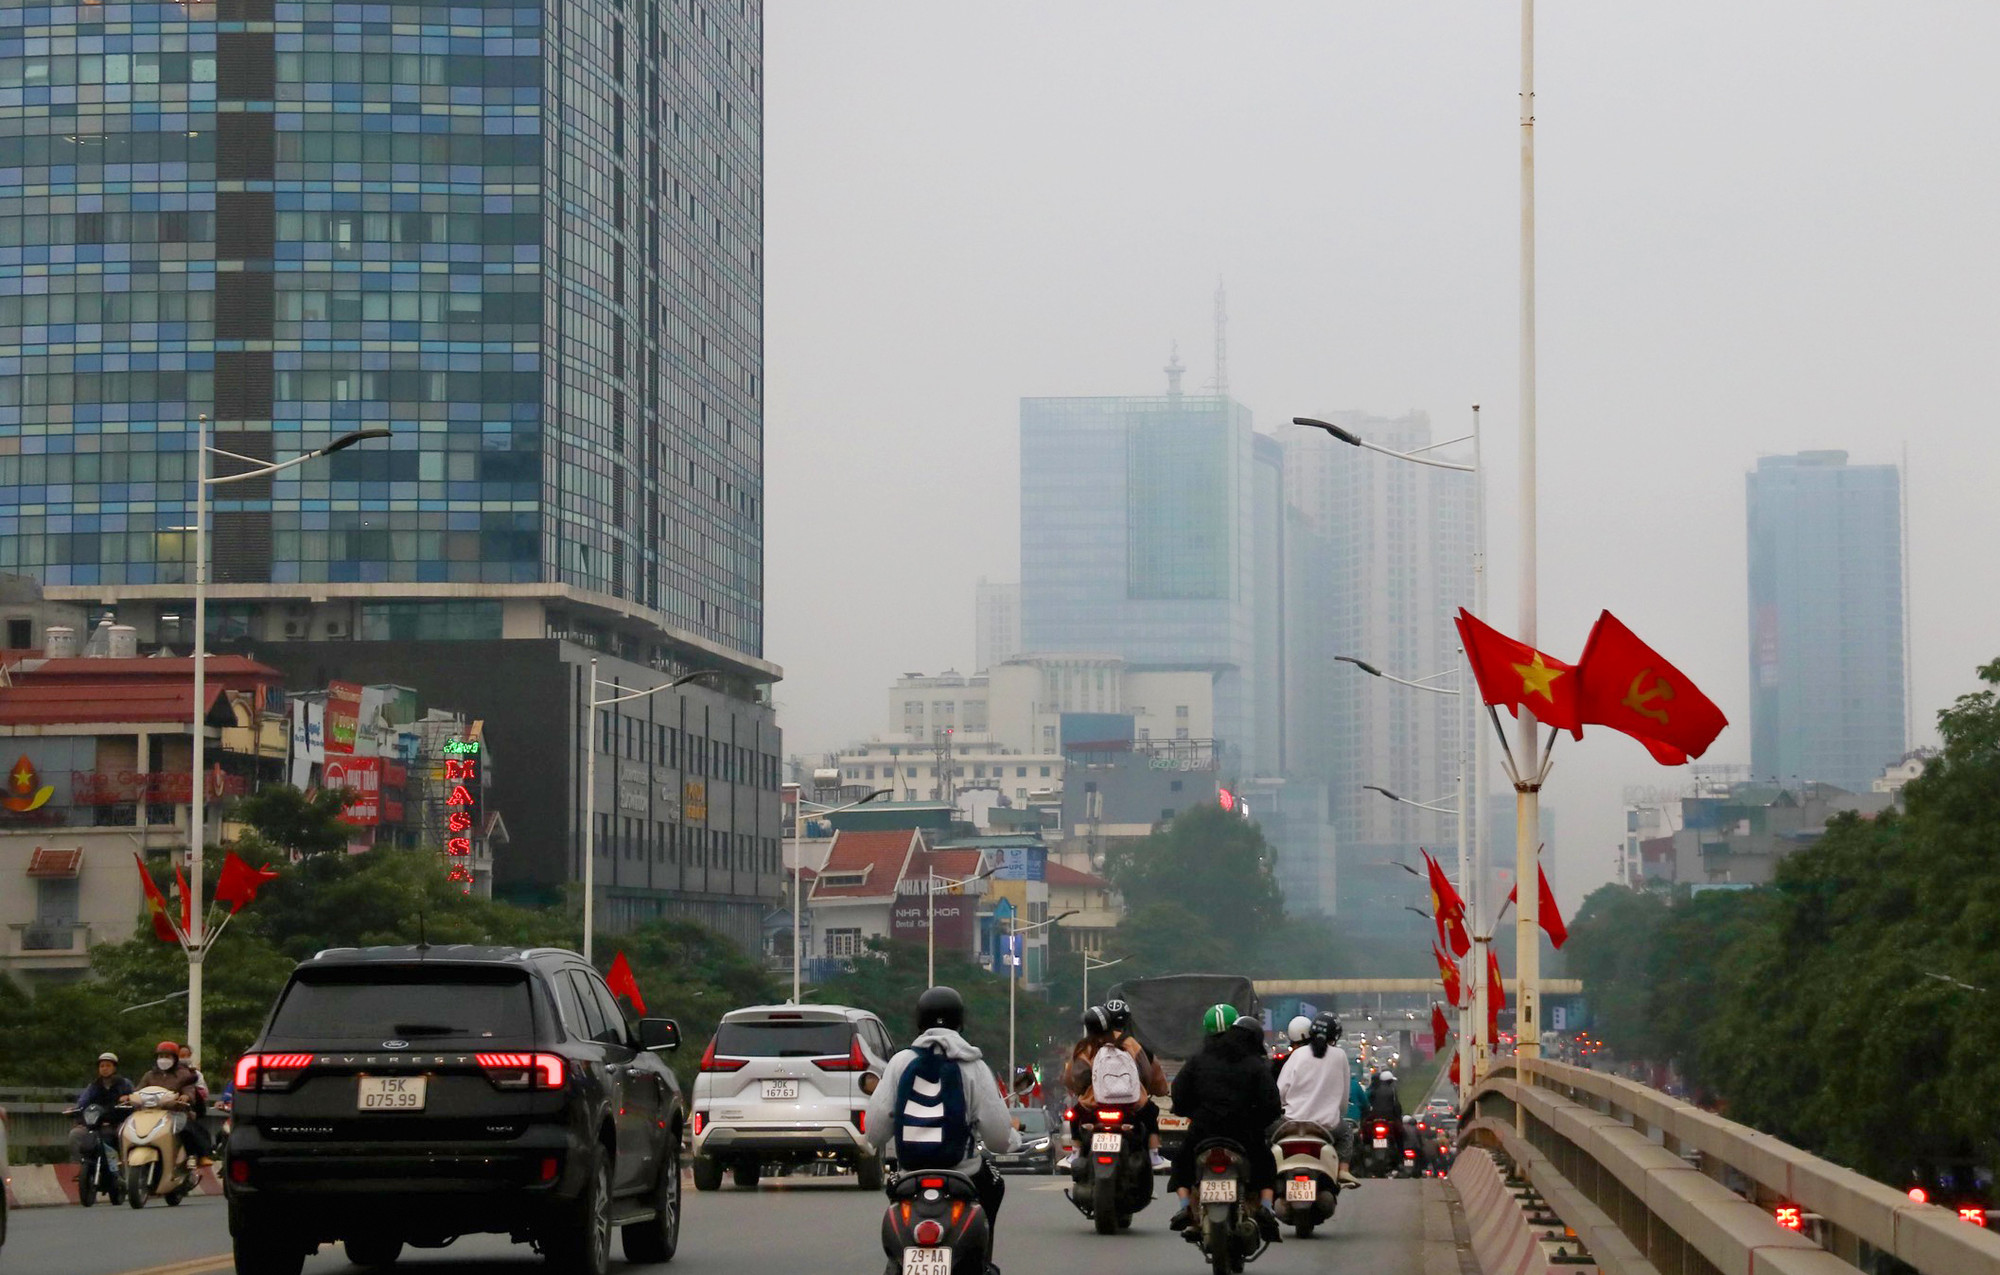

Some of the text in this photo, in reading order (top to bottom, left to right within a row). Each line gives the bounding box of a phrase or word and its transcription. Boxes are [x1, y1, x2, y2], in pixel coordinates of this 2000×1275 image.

[896, 908, 920, 917] NHA
[321, 1056, 467, 1064] EVEREST
[381, 1079, 406, 1092] 15K
[366, 1094, 417, 1107] 075.99
[1206, 1181, 1231, 1191] 29-E1
[911, 1249, 944, 1263] 29-AA
[906, 1264, 947, 1275] 24560
